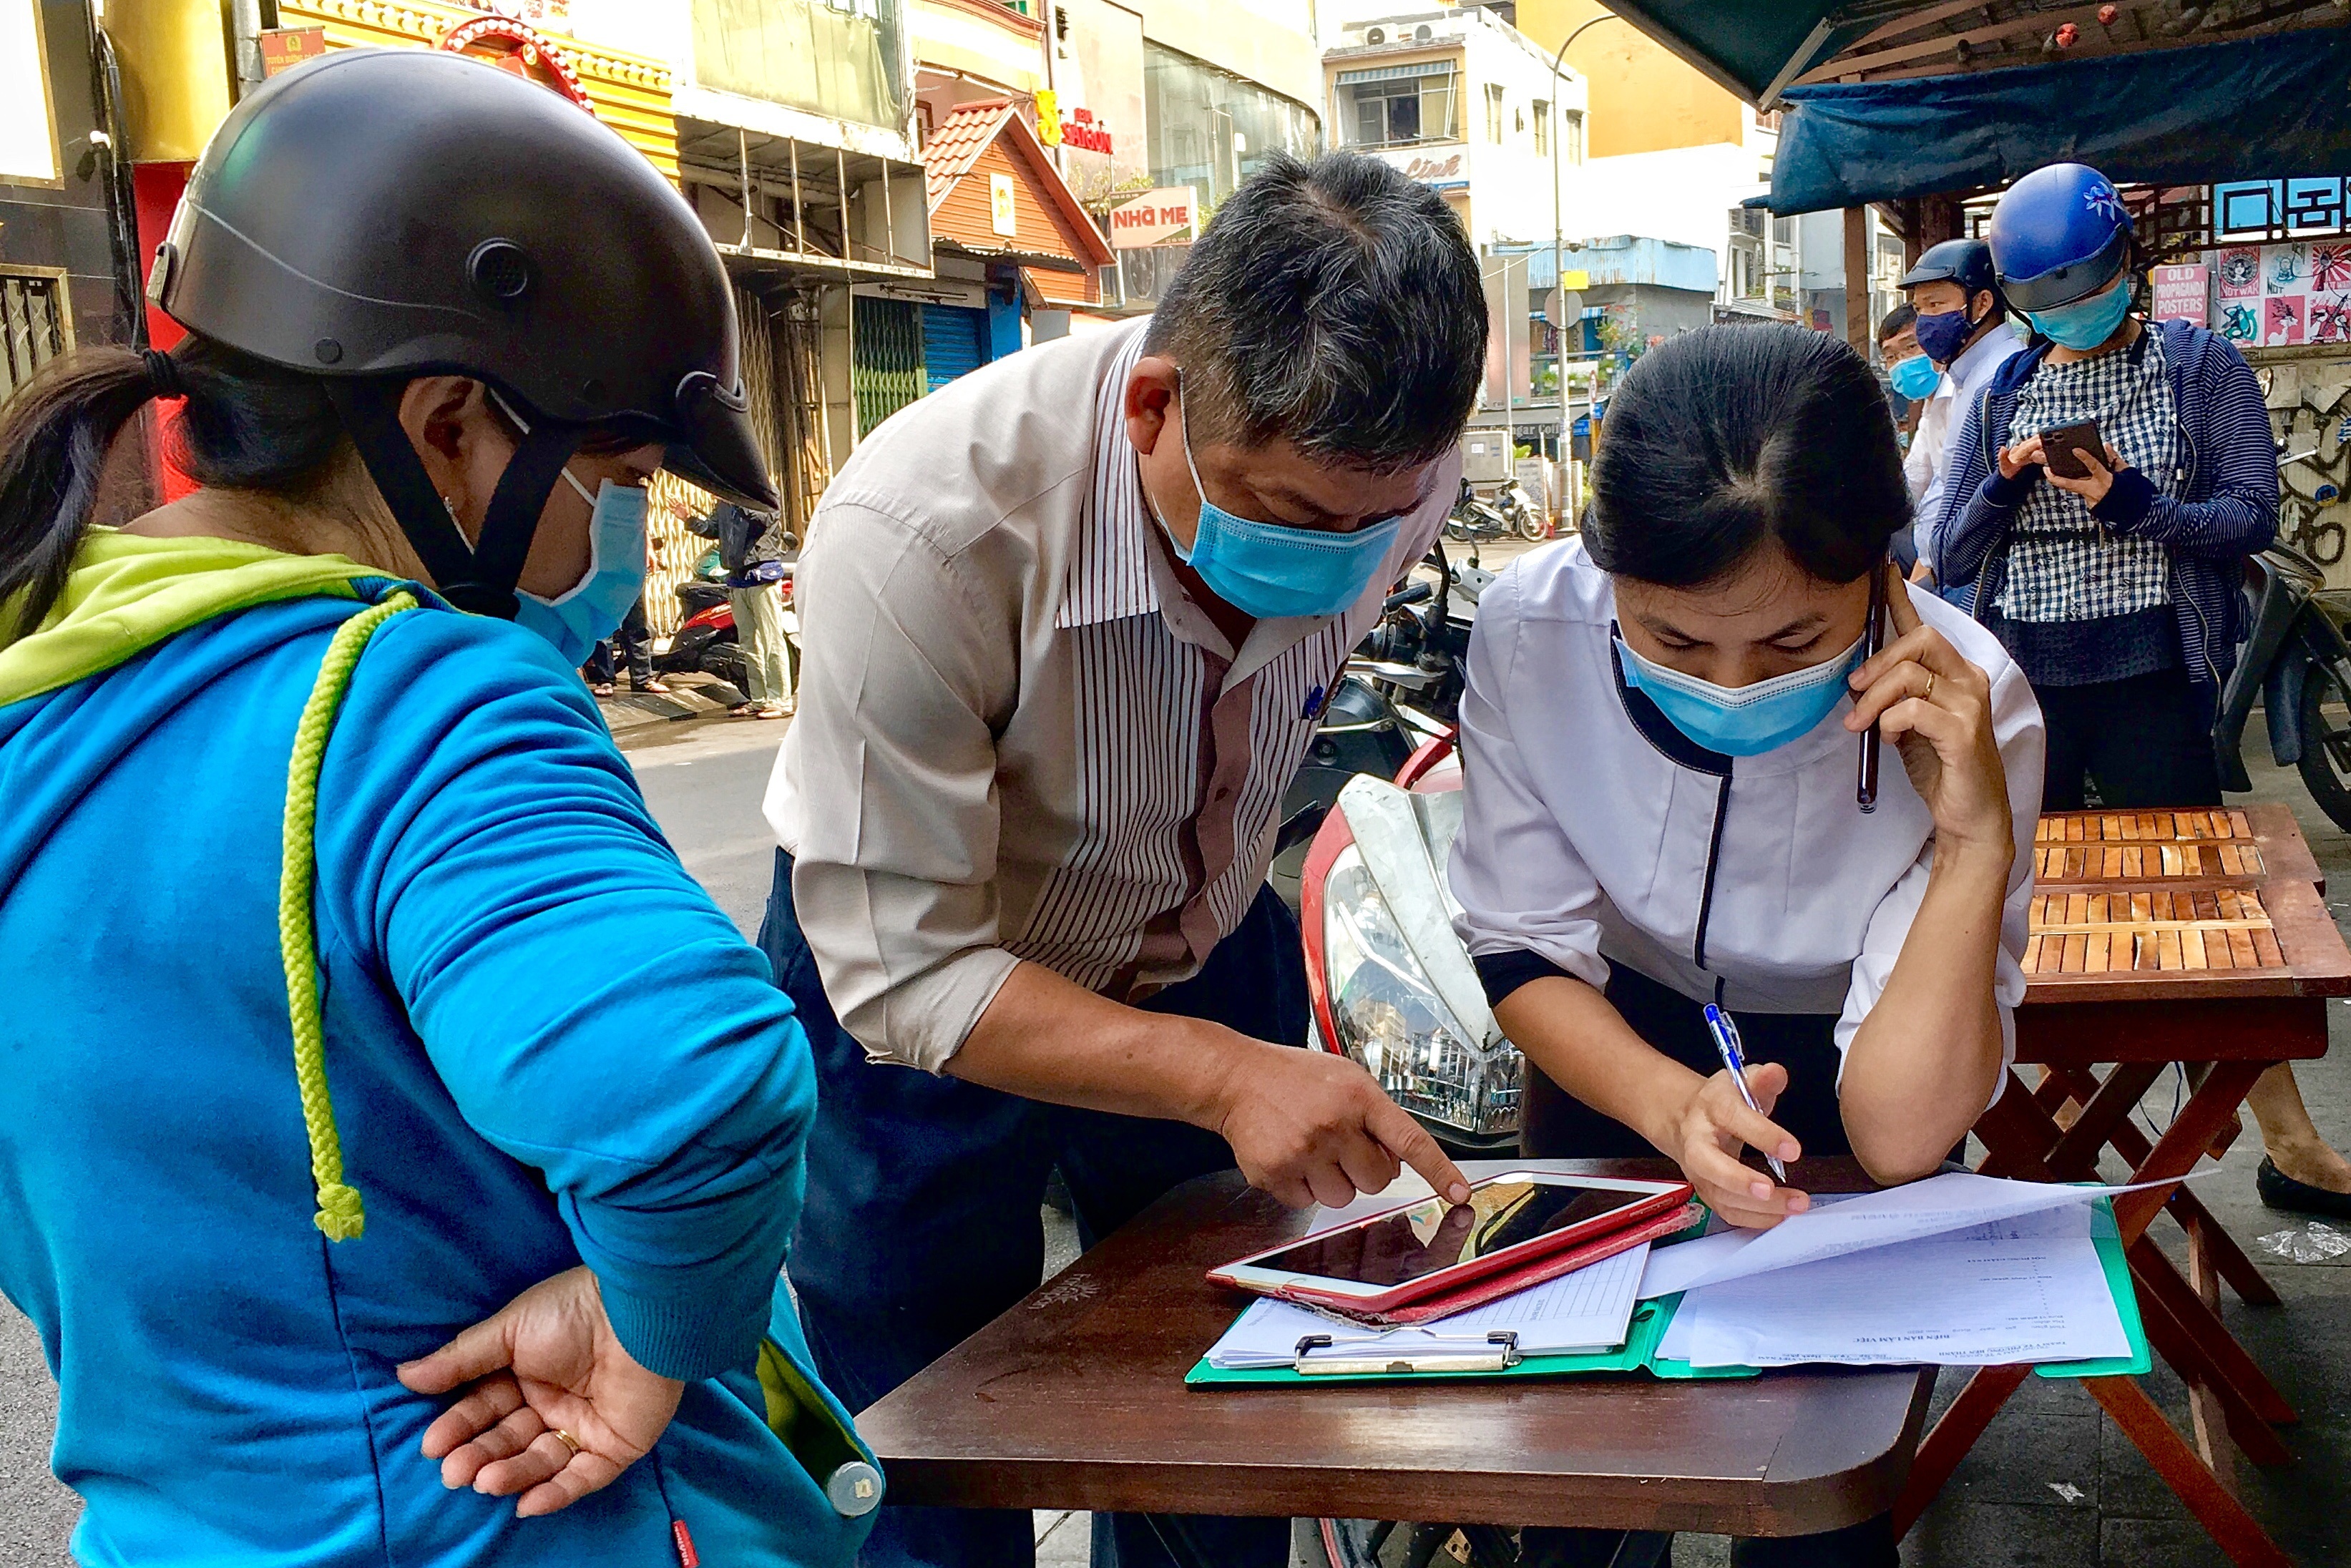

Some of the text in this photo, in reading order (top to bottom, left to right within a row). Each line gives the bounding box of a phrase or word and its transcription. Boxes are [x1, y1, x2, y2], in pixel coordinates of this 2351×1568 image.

[1060, 122, 1113, 155] SAIGON
[1160, 206, 1188, 227] MẸ
[2168, 268, 2194, 281] OLD
[2156, 280, 2205, 298] PROPAGANDA
[2221, 281, 2238, 297] NOT
[2267, 276, 2284, 295] NOT
[2158, 298, 2203, 315] POSTERS
